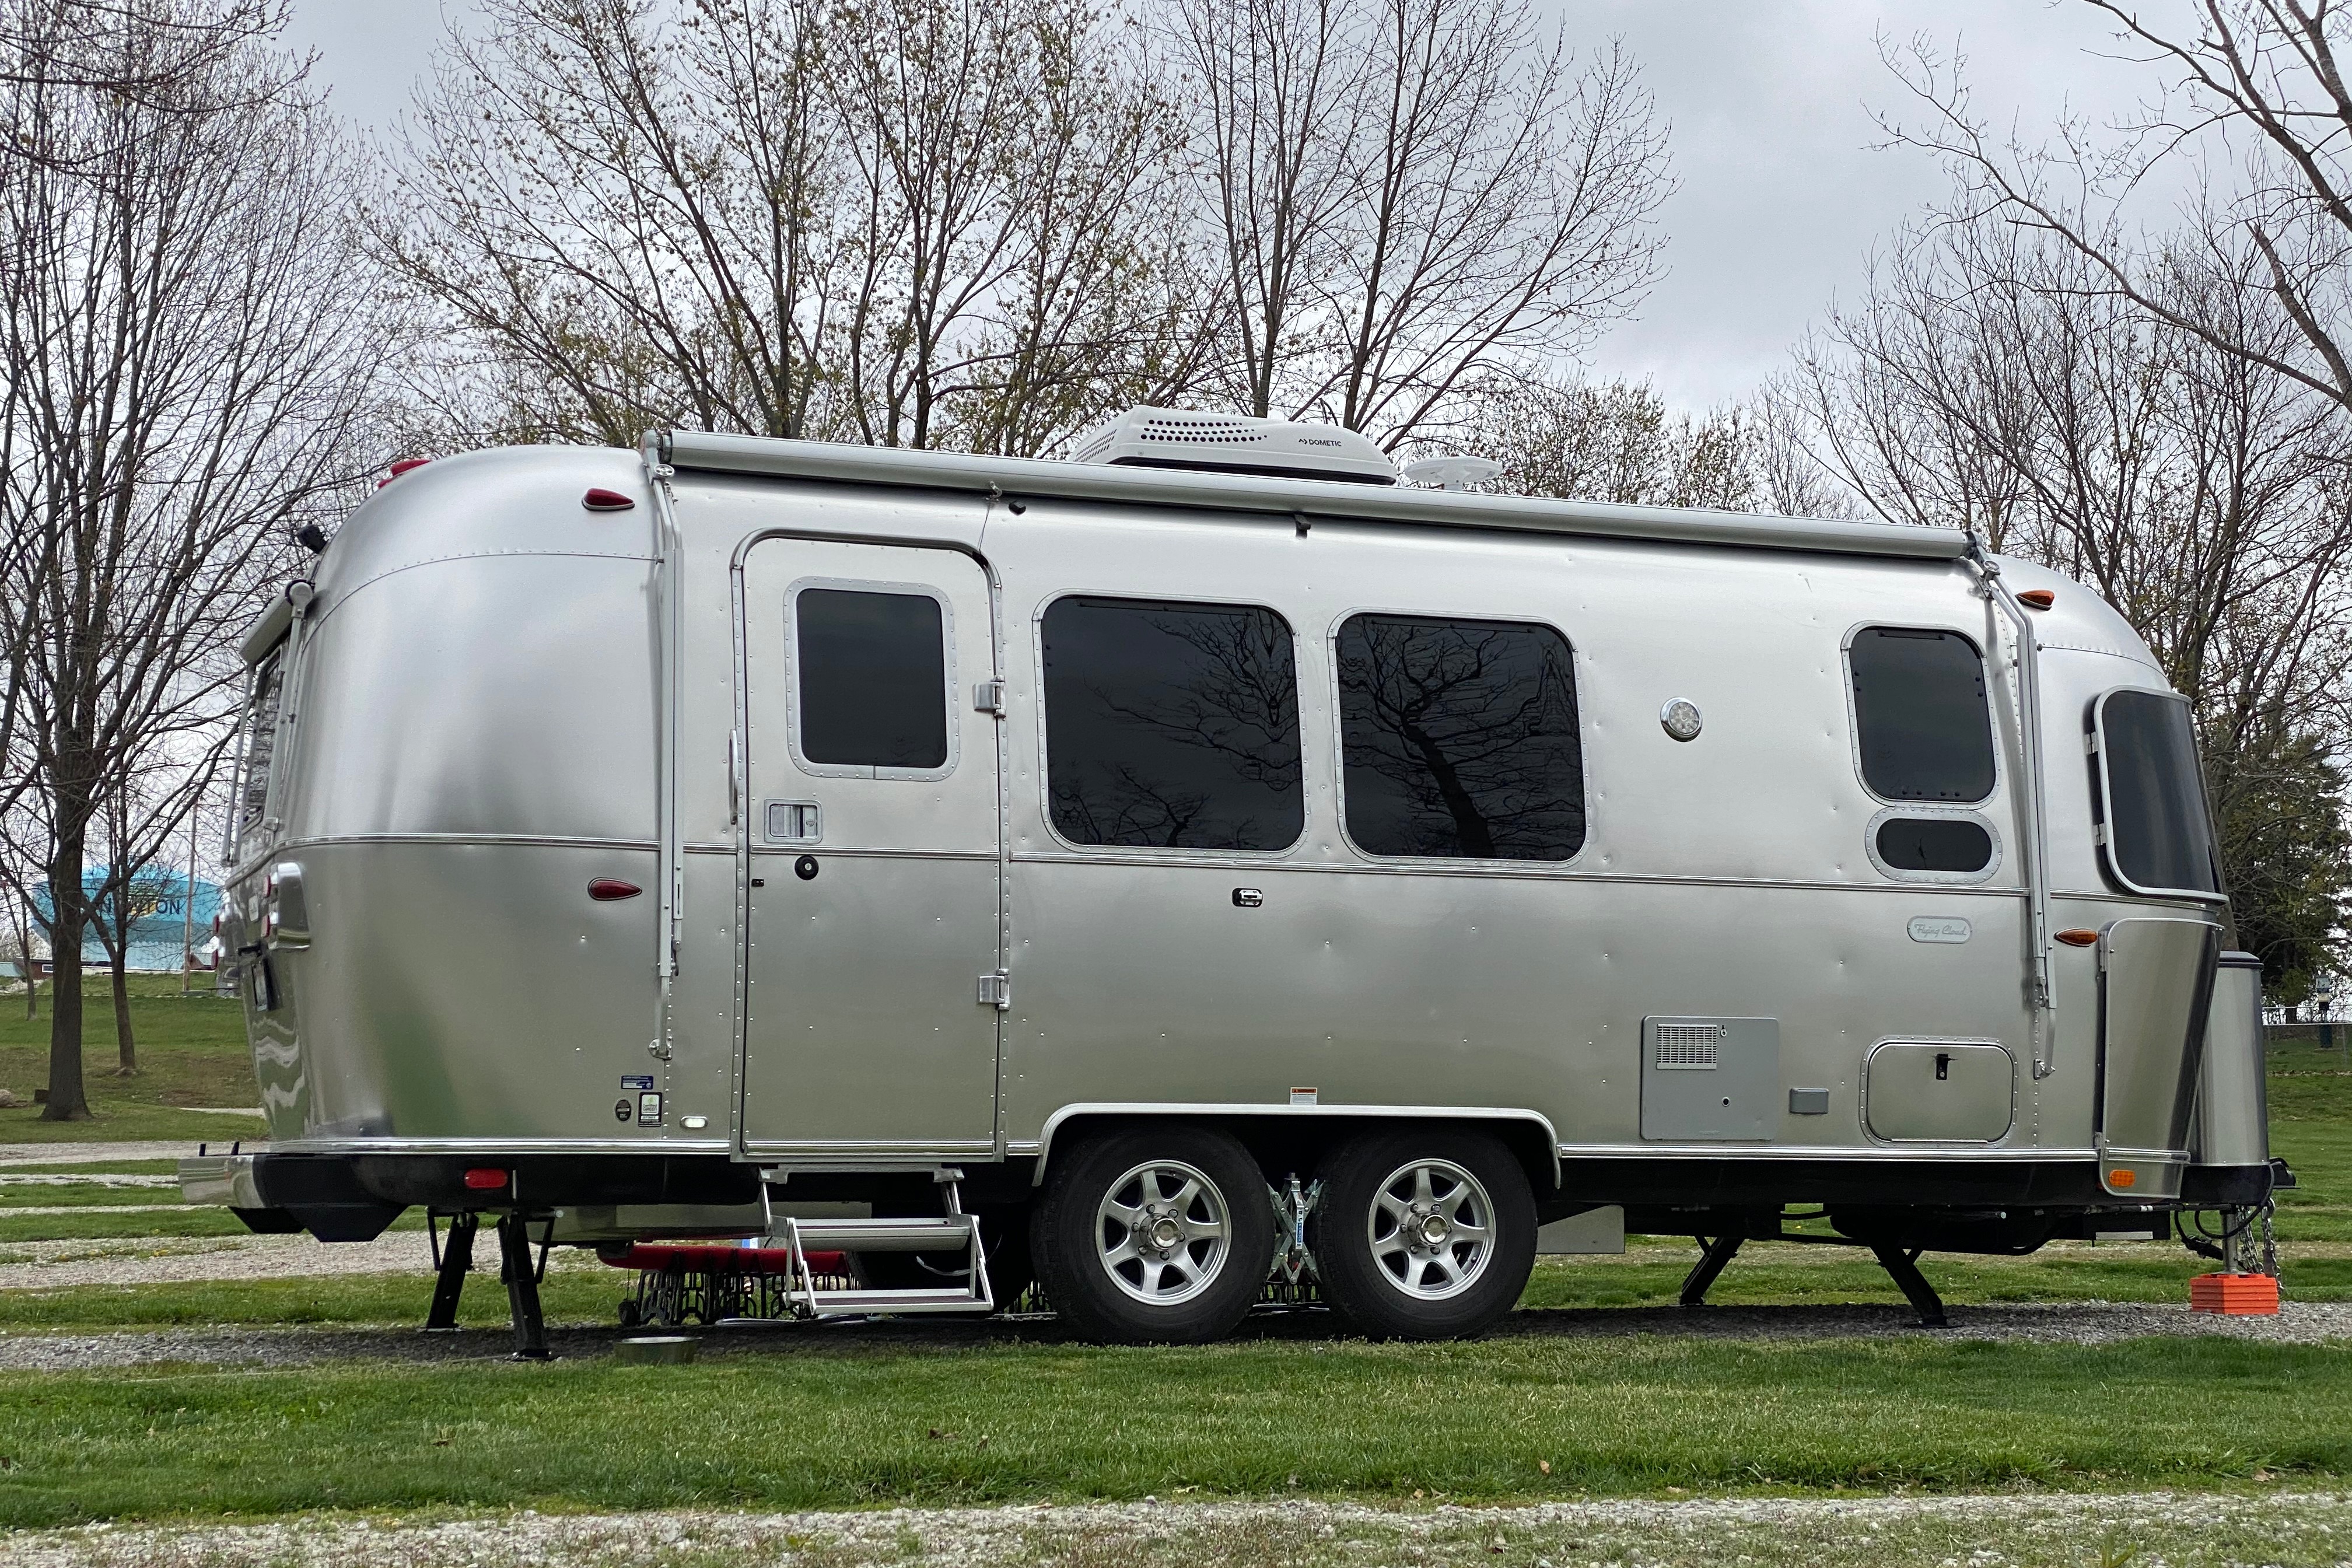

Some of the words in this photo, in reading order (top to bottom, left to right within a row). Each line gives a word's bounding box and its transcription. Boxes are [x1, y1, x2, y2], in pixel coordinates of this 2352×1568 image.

[1308, 439, 1342, 447] DOMETIC
[1914, 923, 1940, 937] Flying
[1942, 925, 1966, 936] Cloud
